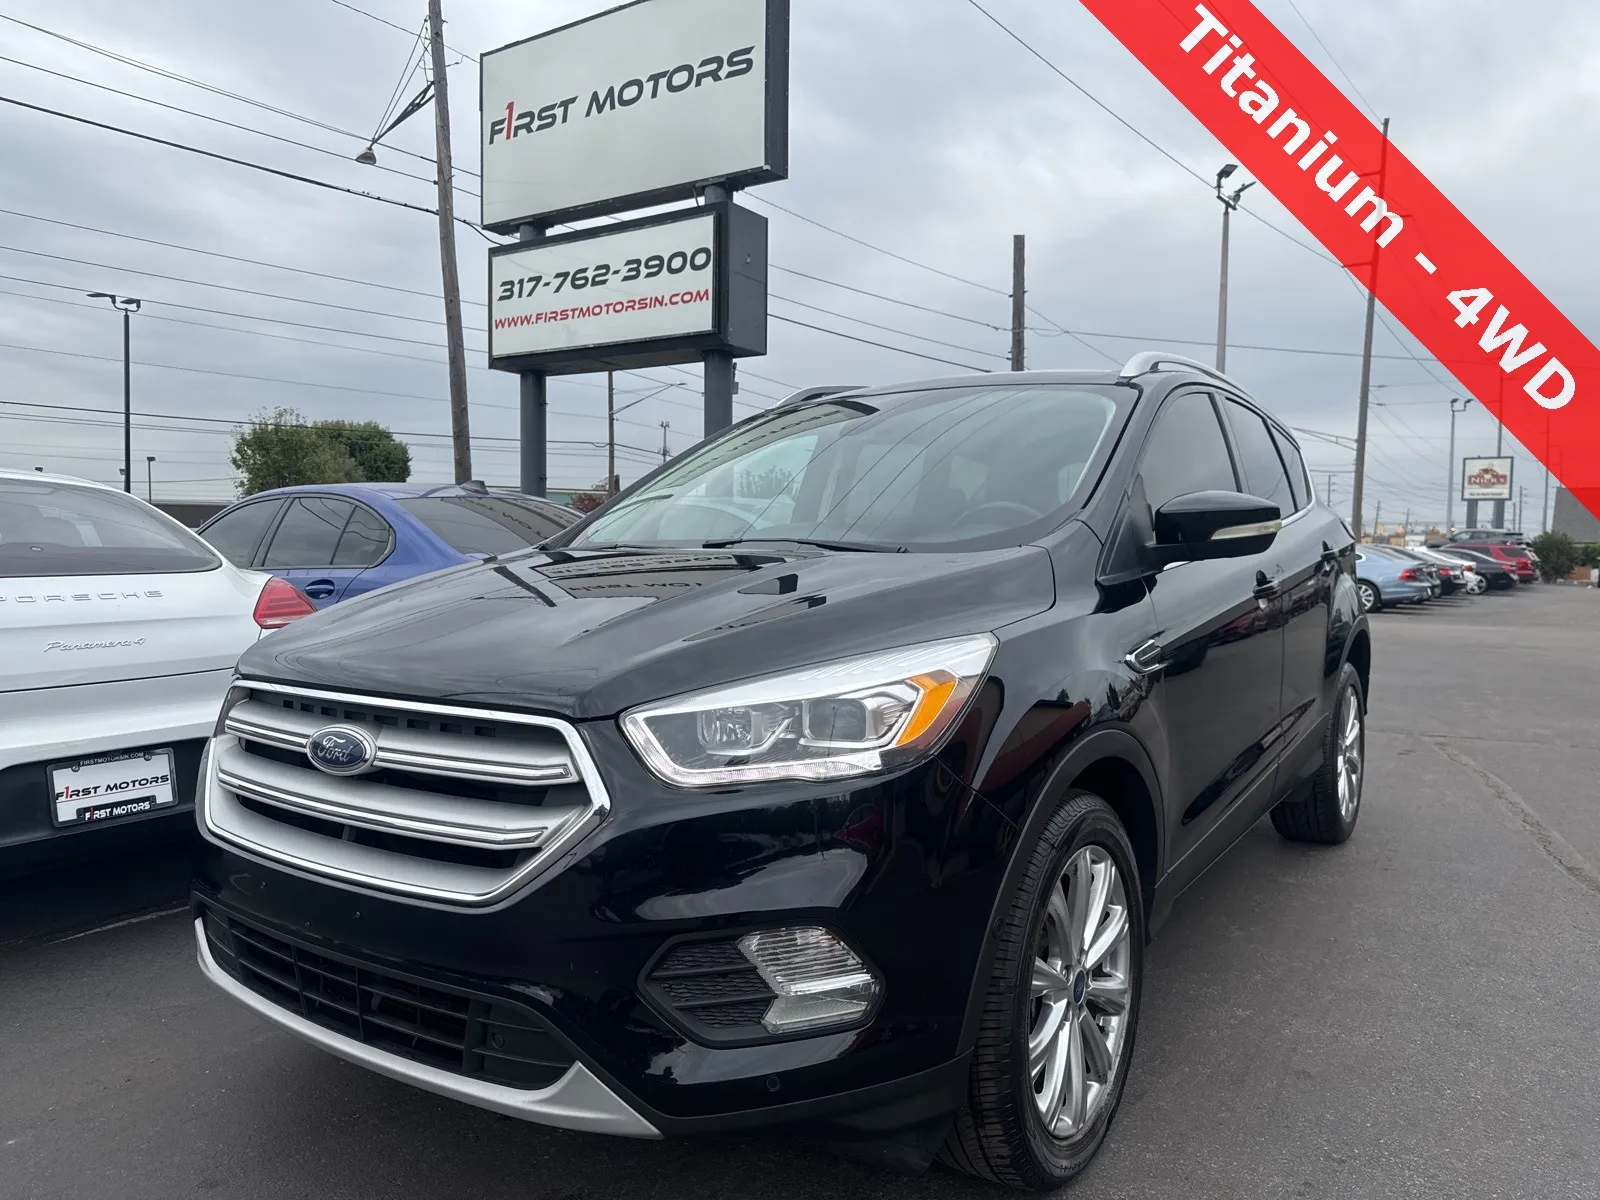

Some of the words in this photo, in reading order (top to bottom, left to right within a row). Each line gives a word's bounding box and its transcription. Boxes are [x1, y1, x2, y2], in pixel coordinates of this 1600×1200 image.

[585, 45, 755, 119] MOTORS
[497, 247, 712, 302] 317-762-3900
[494, 288, 710, 331] WWW.FIRSTMOTORSIN.COM
[44, 639, 132, 652] Panamera
[133, 637, 145, 646] 4
[317, 735, 354, 762] Ford
[105, 774, 170, 793] MOTORS
[112, 801, 151, 816] MOTORS
